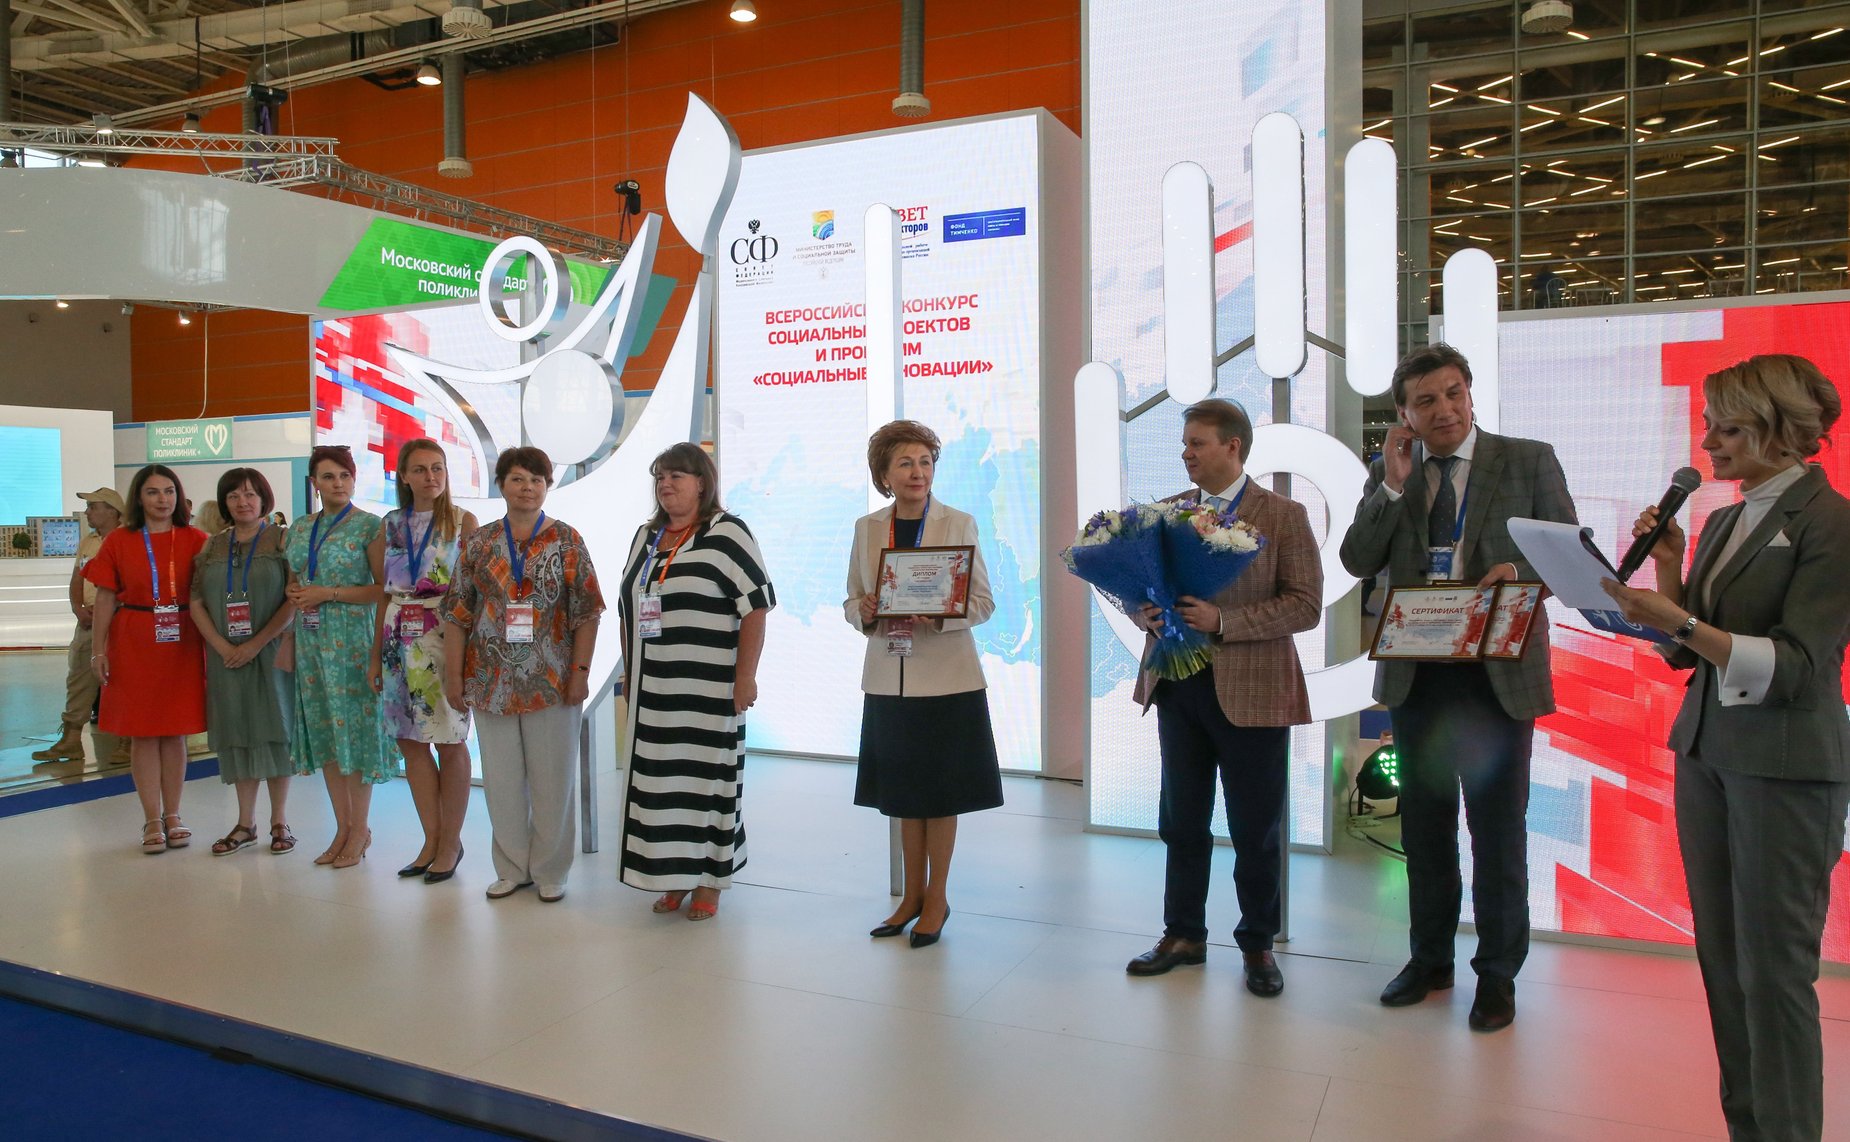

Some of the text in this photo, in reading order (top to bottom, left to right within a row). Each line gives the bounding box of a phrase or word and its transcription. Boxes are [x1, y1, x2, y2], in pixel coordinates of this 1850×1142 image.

[897, 206, 928, 222] ВЕТ
[901, 223, 928, 236] кторов
[730, 235, 778, 265] СФ
[381, 246, 471, 280] Московский
[418, 279, 478, 298] поликли
[765, 294, 979, 325] ВСЕРОССИЙС КОНКУРС
[768, 317, 971, 345] СОЦИАЛЬНЫ ОЕКТОВ
[816, 349, 826, 362] И
[902, 360, 993, 378] ОВАЦИИ»
[155, 424, 199, 436] МОСКОВСКИЙ
[161, 437, 193, 447] СТАНДАРТ
[1411, 607, 1464, 615] СЕРТИФИКАТ
